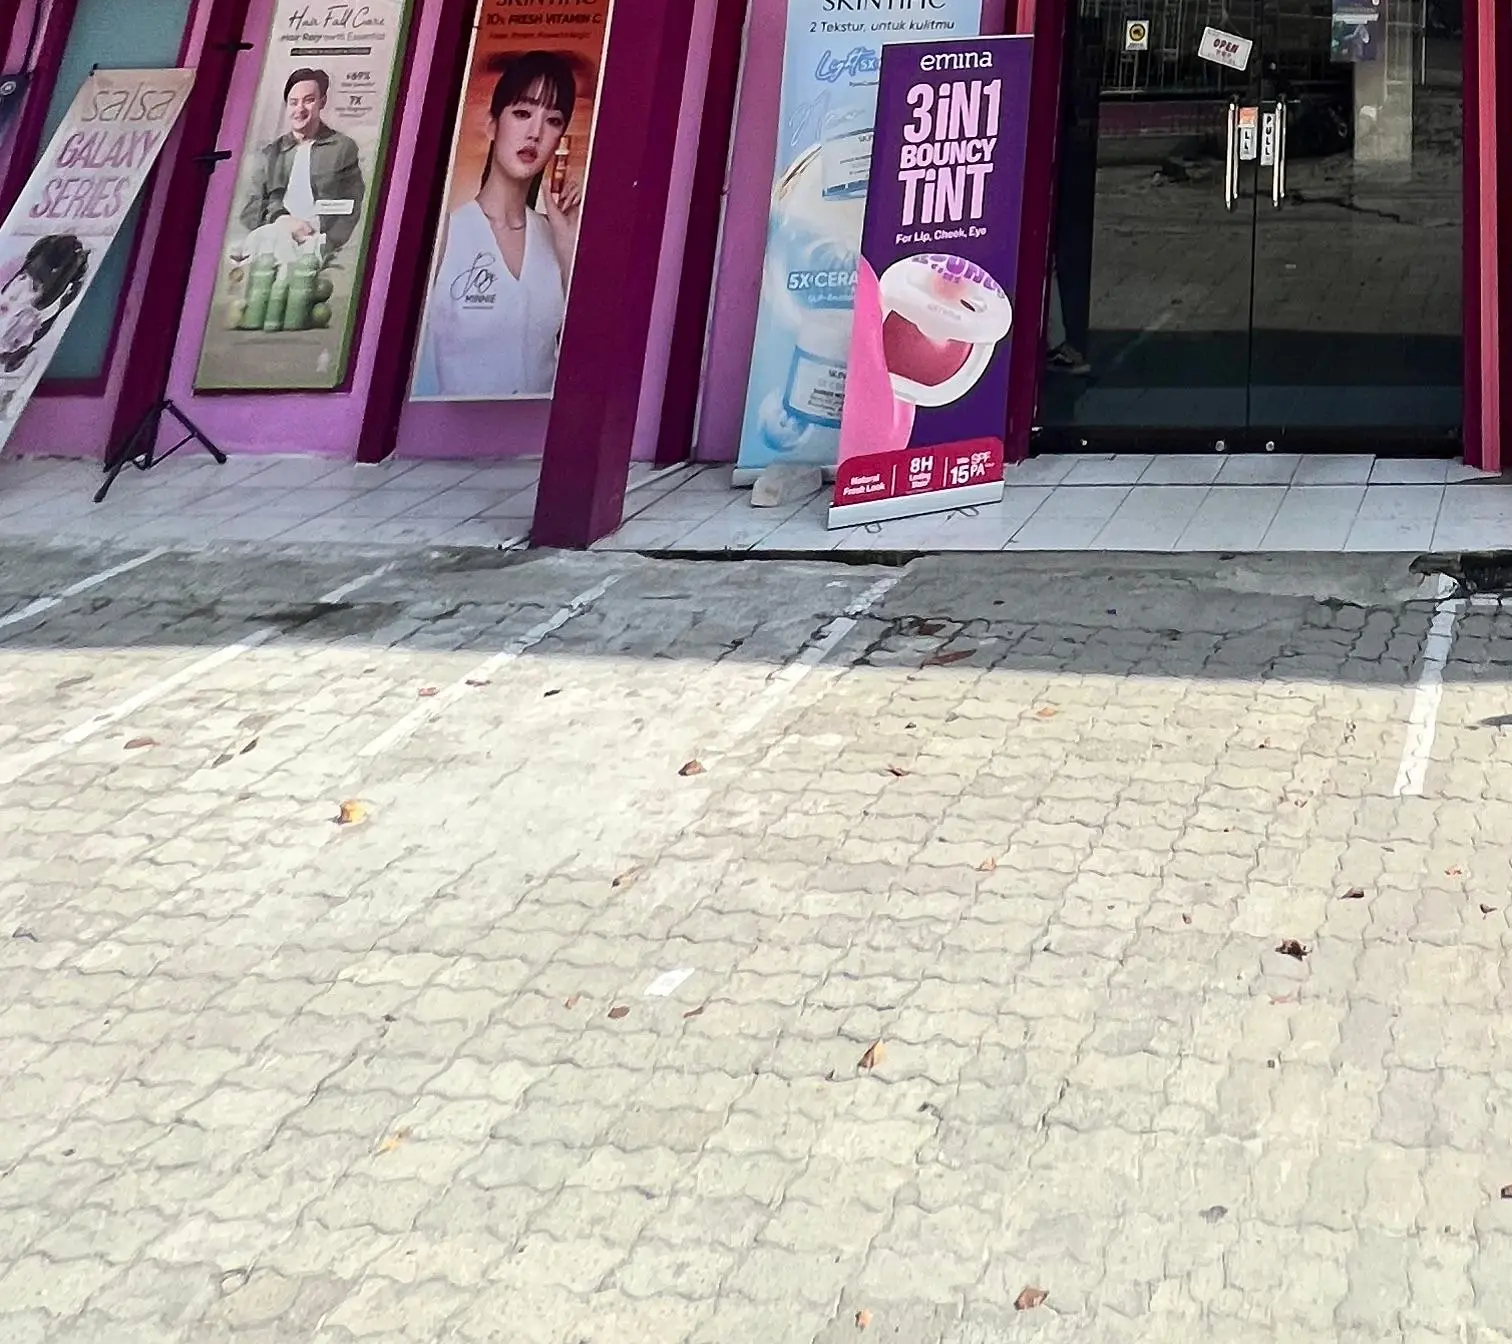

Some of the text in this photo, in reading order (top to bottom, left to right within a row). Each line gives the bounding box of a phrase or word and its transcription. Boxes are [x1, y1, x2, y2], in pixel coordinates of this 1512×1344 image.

[289, 4, 385, 31] Hair Fall Care
[507, 14, 543, 25] FRESH
[545, 13, 589, 25] VITAMIN
[592, 13, 601, 24] C
[809, 21, 817, 33] 2
[870, 20, 905, 32] untuk
[908, 19, 955, 31] kulitmu
[1212, 37, 1240, 55] OPEN
[920, 50, 993, 72] emina
[81, 82, 176, 122] salsa
[1264, 115, 1273, 156] PULL
[56, 129, 162, 169] GALAXY
[899, 137, 998, 169] BOUNCY
[29, 174, 130, 220] SERIES
[895, 226, 987, 245] For Lip, Cheek, Eye
[788, 272, 811, 290] 5X
[909, 455, 934, 473] 8H
[950, 464, 970, 485] 15
